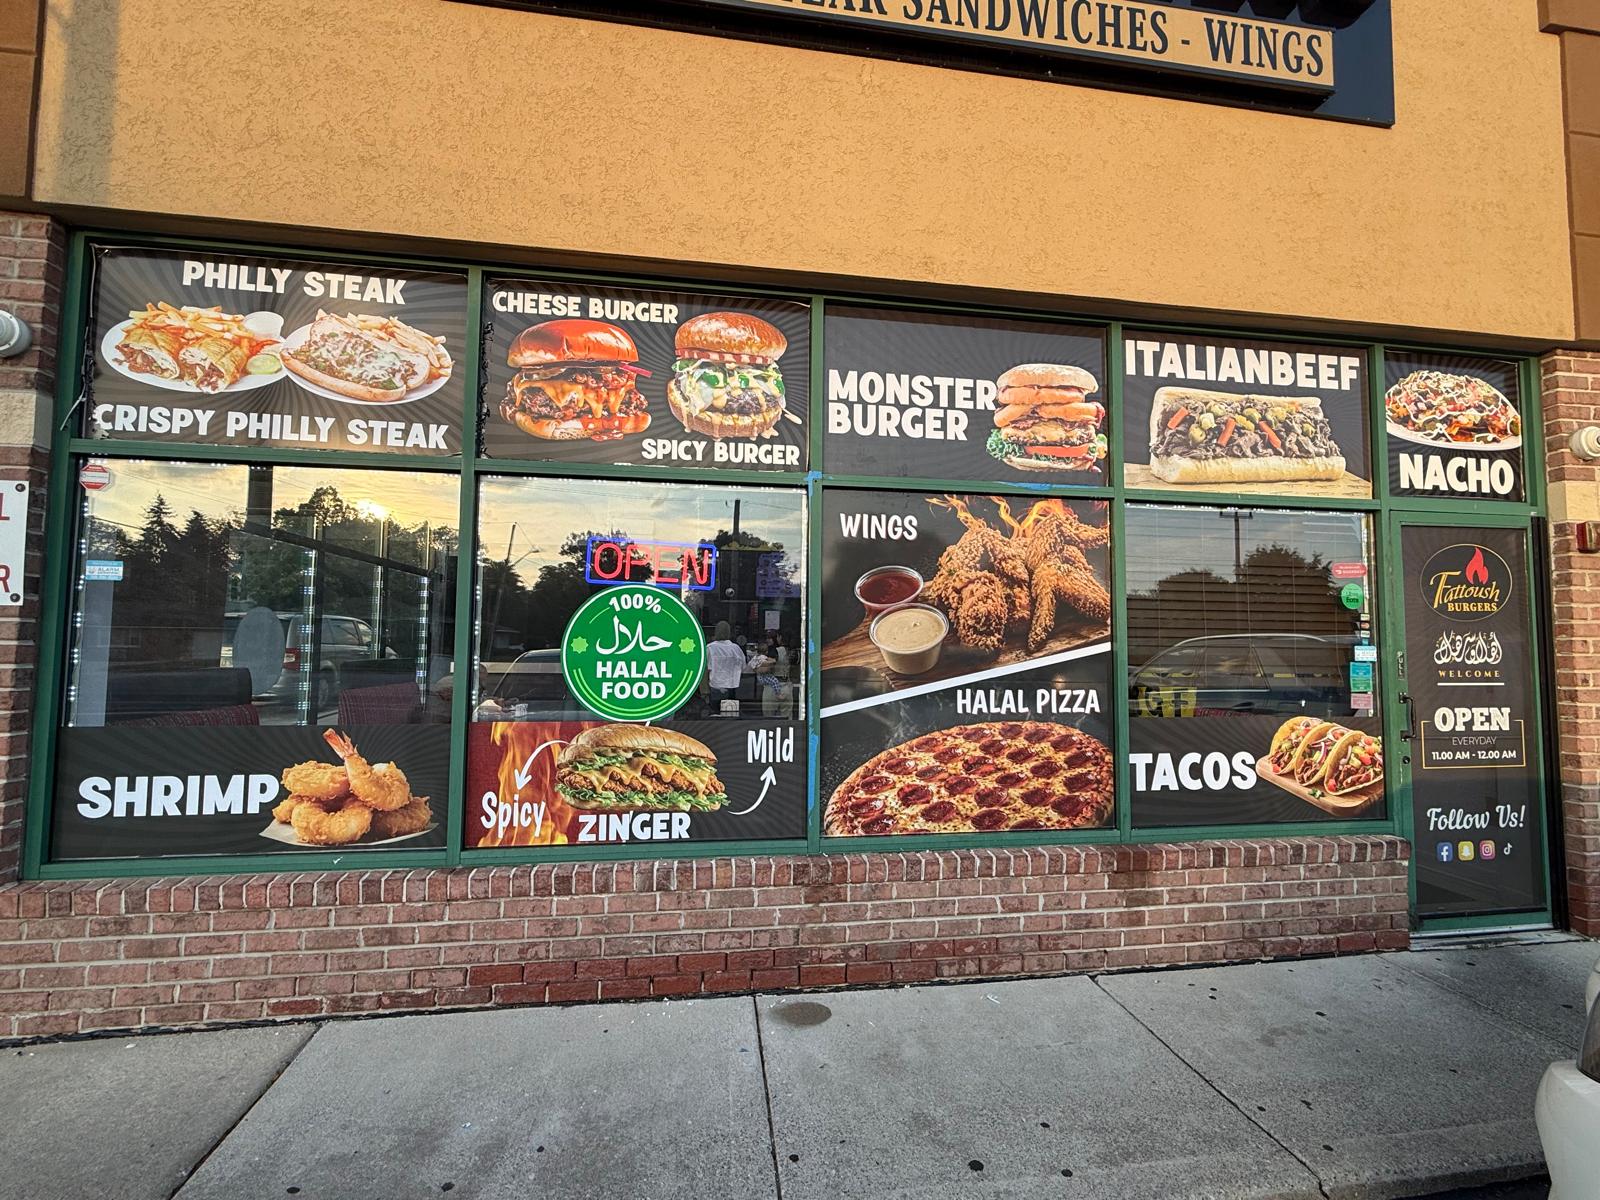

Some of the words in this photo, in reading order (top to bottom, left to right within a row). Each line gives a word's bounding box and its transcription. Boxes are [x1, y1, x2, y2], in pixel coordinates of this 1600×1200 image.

[1204, 18, 1323, 76] WINGS
[183, 260, 292, 294] PHILLY
[303, 271, 406, 304] STEAK
[492, 291, 581, 317] CHEESE
[589, 300, 678, 324] BURGER
[1124, 339, 1360, 391] ITALIANBEEF
[828, 369, 999, 411] MONSTER
[93, 403, 215, 435] CRISPY
[226, 411, 333, 443] PHILLY
[346, 419, 448, 449] STEAK
[828, 402, 968, 441] BURGER
[641, 439, 707, 461] SPICY
[714, 441, 800, 465] BURGER
[1399, 453, 1514, 495] NACHO
[839, 513, 918, 541] WINGS
[594, 542, 709, 584] OPEN
[609, 593, 662, 614] 100%
[1430, 571, 1500, 608] Fattoush
[1448, 602, 1498, 612] BURGERS
[596, 615, 673, 655] حلال
[596, 661, 672, 678] HALAL
[1438, 670, 1500, 678] WELCOME
[601, 682, 666, 699] FOOD
[956, 689, 1028, 715] HALAL
[1037, 689, 1100, 713] PIZZA
[1434, 707, 1510, 732] OPEN
[747, 727, 794, 763] Mild
[1432, 751, 1453, 760] 11.00
[1455, 751, 1470, 760] AM
[1477, 750, 1499, 759] 12.00
[1501, 750, 1516, 759] AM
[1452, 736, 1497, 746] EVERYDAY
[1129, 751, 1257, 791] TACOS
[77, 774, 280, 818] SHRIMP
[481, 791, 546, 838] Spicy
[577, 812, 691, 841] ZINGER
[1427, 807, 1490, 831] Follow
[1496, 804, 1526, 828] Us!
